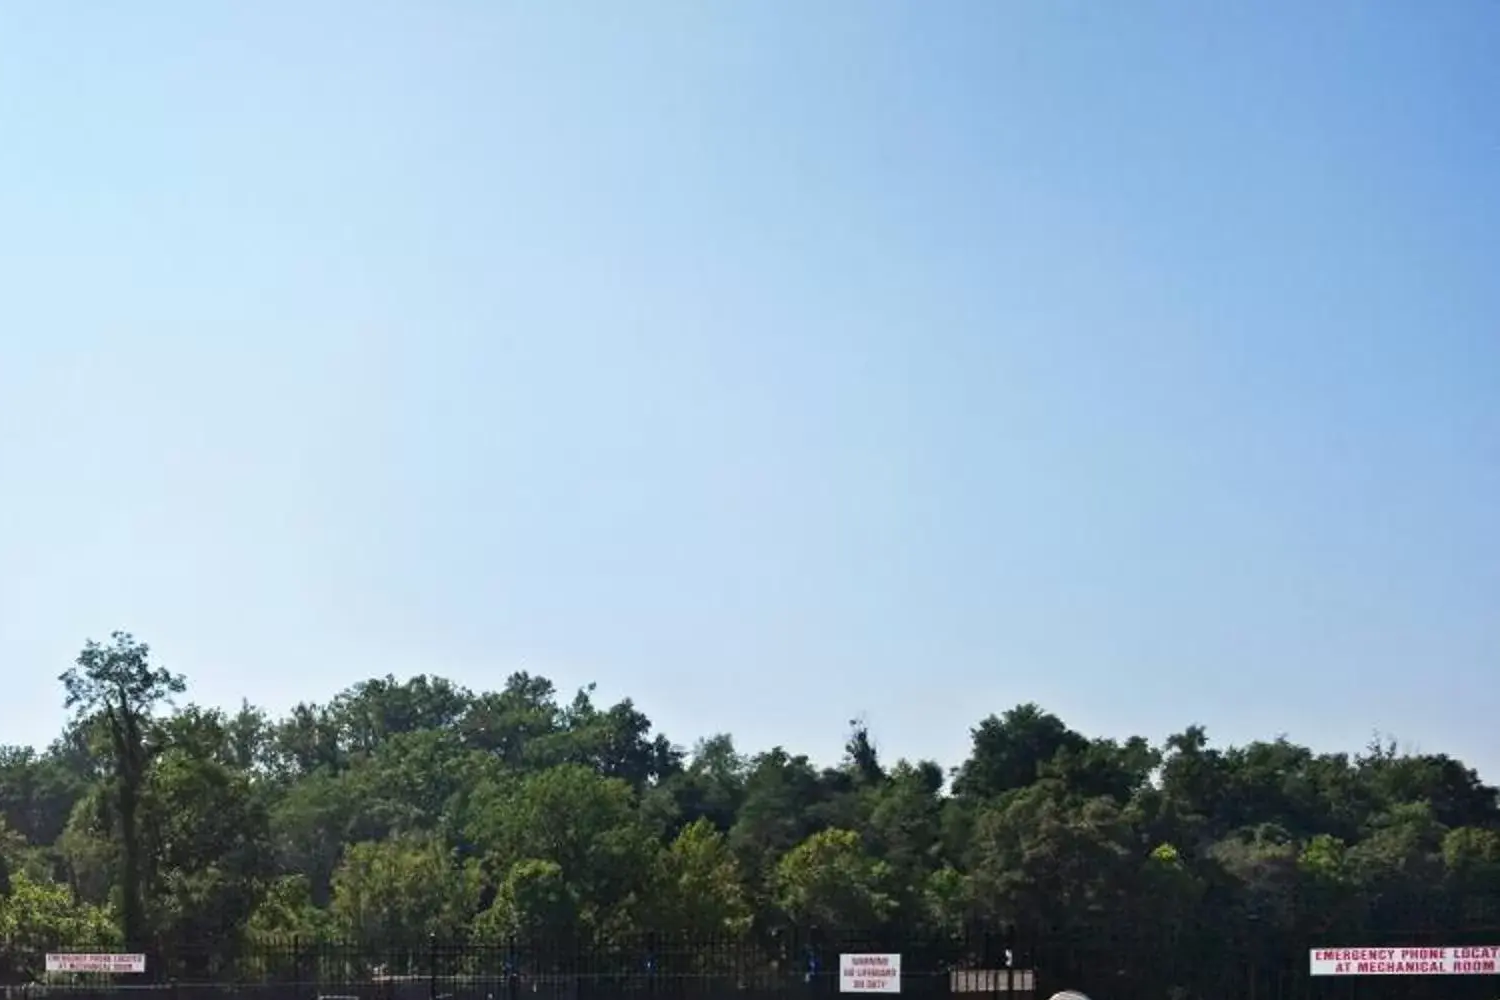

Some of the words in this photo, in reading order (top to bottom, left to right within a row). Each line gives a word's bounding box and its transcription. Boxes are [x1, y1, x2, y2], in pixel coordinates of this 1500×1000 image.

[1315, 950, 1395, 960] EMERGENCY
[1402, 949, 1446, 959] PHONE
[1335, 962, 1351, 973] AT
[1357, 961, 1446, 973] MECHANICAL
[1453, 960, 1495, 971] ROOM
